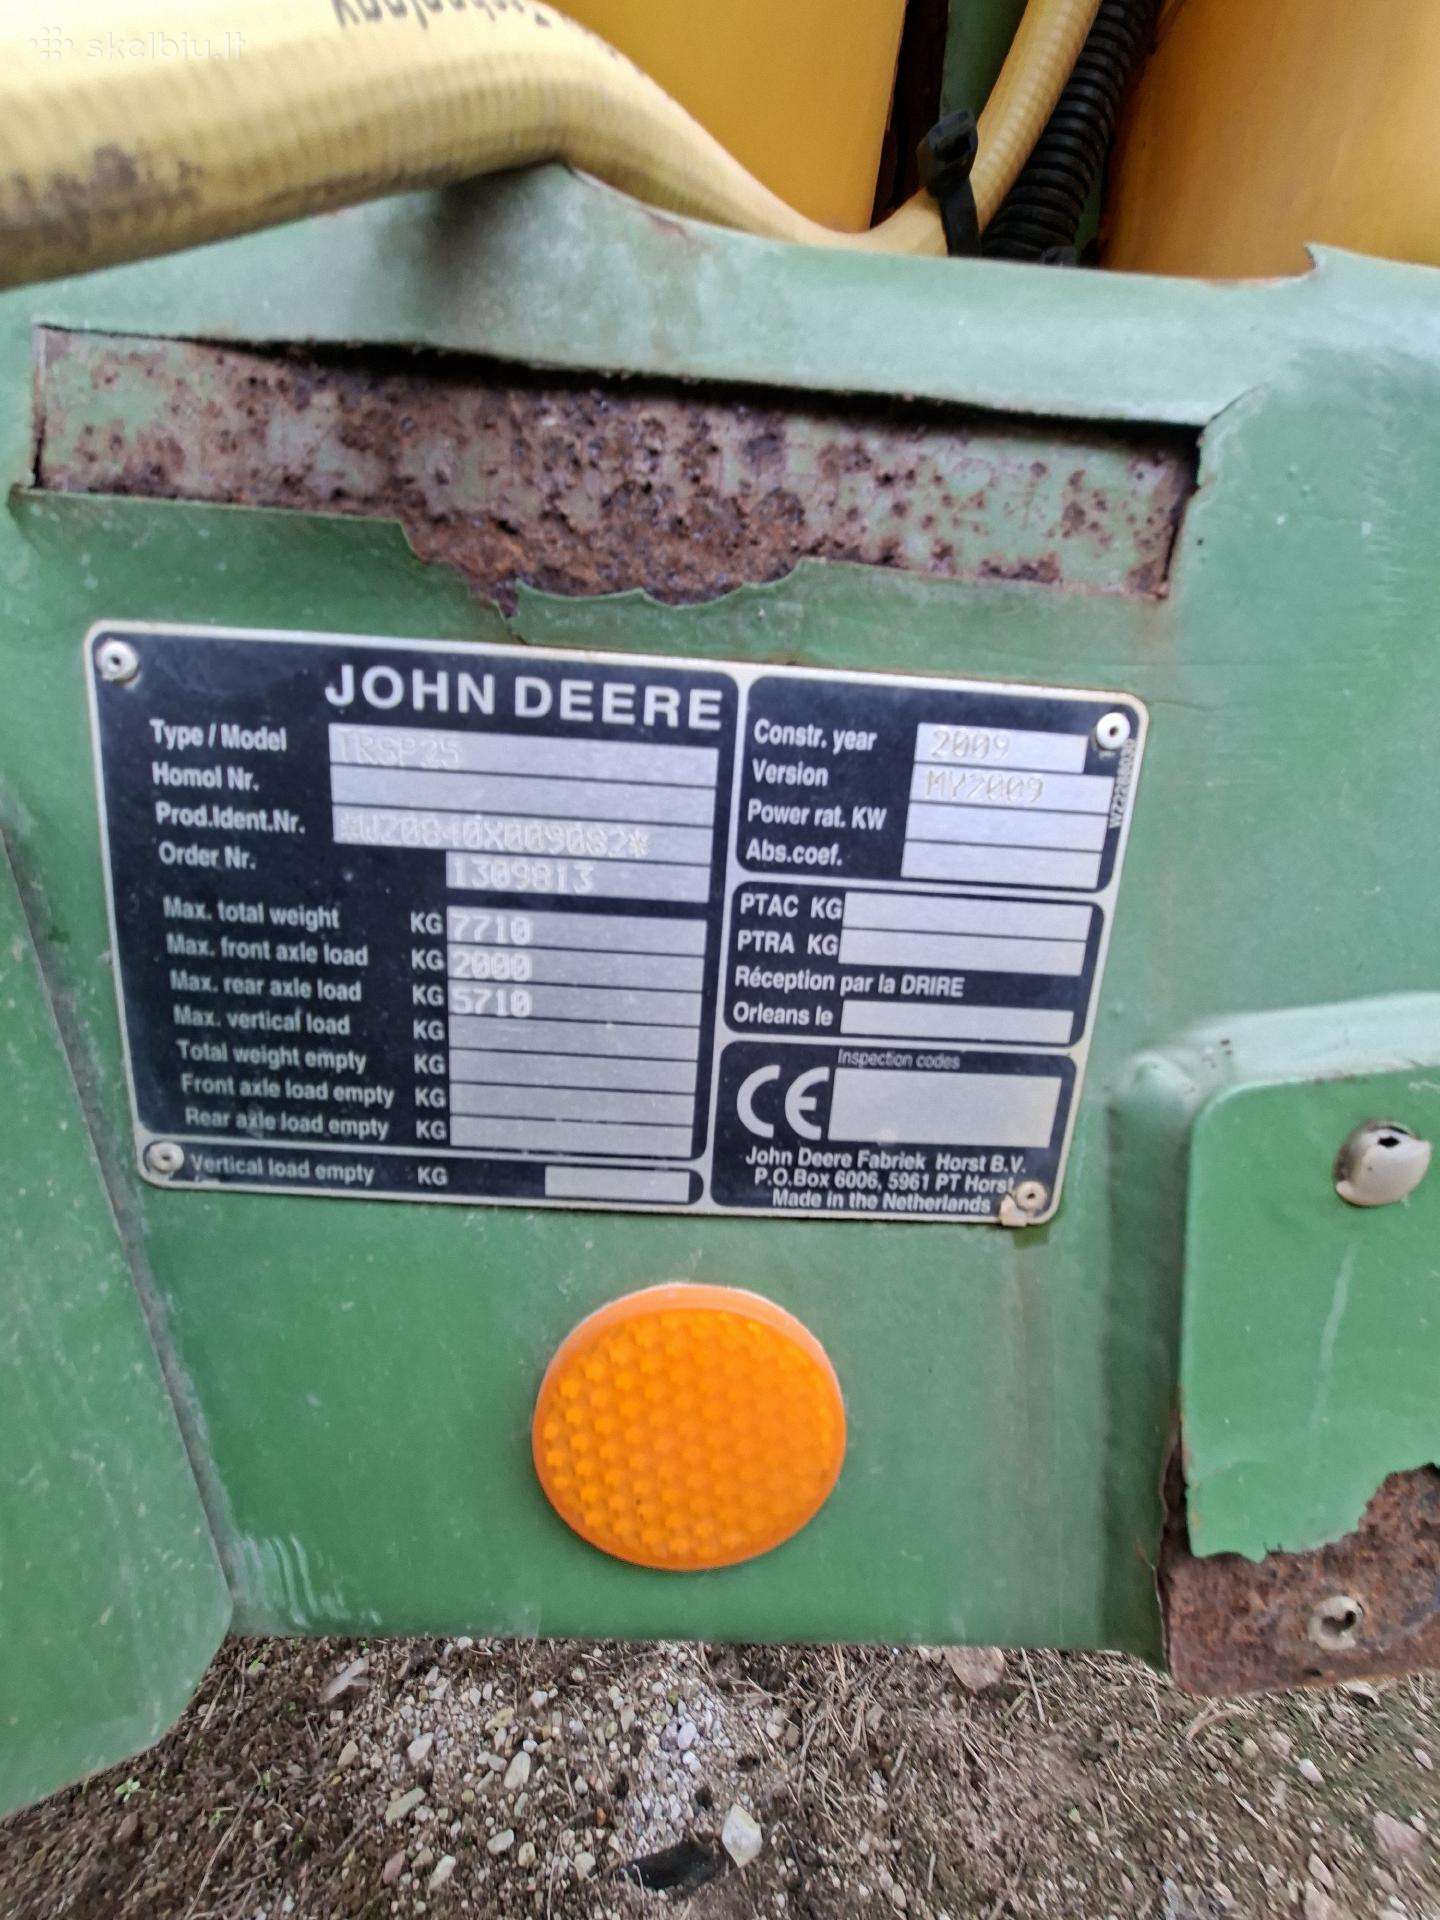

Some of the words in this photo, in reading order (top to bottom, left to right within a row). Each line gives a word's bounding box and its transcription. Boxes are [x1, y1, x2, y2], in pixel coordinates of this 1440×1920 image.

[325, 664, 496, 715] JOHN
[514, 676, 723, 730] DEERE
[149, 718, 204, 751] Type
[220, 724, 287, 752] Model
[753, 718, 828, 749] Constr.
[832, 730, 878, 754] year
[931, 728, 1010, 761] 2009
[152, 761, 222, 788] Homol
[228, 766, 259, 792] Nr.
[752, 759, 828, 787] Version
[747, 799, 810, 827] Power
[814, 806, 847, 828] rat.
[851, 807, 888, 830] KW
[158, 841, 220, 868] Order
[225, 845, 256, 870] Nr.
[746, 838, 842, 866] Abs.coef.
[162, 896, 212, 920] Max.
[217, 900, 264, 924] total
[269, 904, 340, 933] weight
[410, 911, 444, 935] KG
[740, 892, 799, 918] PTAC
[810, 896, 843, 921] KG
[451, 912, 533, 945] 7710
[737, 930, 795, 954] PTRA
[807, 933, 839, 956] KG
[166, 932, 215, 957] Max.
[220, 936, 270, 960] front
[275, 941, 318, 964] axle
[323, 943, 369, 967] load
[411, 949, 444, 971] KG
[451, 951, 533, 981] 2000
[170, 969, 218, 993] Max.
[223, 977, 264, 996] rear
[269, 977, 312, 999] axle
[317, 979, 362, 1002] load
[412, 985, 444, 1006] KG
[735, 965, 835, 994] Réception
[840, 976, 874, 996] par
[878, 973, 896, 994] la
[901, 974, 965, 998] DRIRE
[451, 988, 533, 1017] 5710
[733, 1001, 810, 1026] Orleans
[815, 1005, 833, 1026] le
[173, 1004, 221, 1027] Max.
[226, 1008, 301, 1033] vertical
[306, 1013, 350, 1036] load
[413, 1020, 446, 1041] KG
[176, 1039, 228, 1062] Total
[233, 1044, 299, 1071] weight
[305, 1051, 367, 1074] empty
[413, 1054, 446, 1075] KG
[838, 1049, 913, 1069] Inspection
[916, 1052, 961, 1070] codes
[181, 1073, 235, 1096] Front
[239, 1076, 281, 1099] axle
[285, 1079, 328, 1100] load
[333, 1086, 395, 1109] empty
[414, 1088, 446, 1108] KG
[185, 1106, 230, 1128] Rear
[236, 1109, 277, 1131] axle
[281, 1112, 324, 1133] load
[328, 1119, 390, 1142] empty
[416, 1120, 447, 1141] KG
[190, 1154, 263, 1177] Vertical
[268, 1158, 310, 1180] load
[315, 1165, 375, 1188] empty
[417, 1166, 448, 1187] KG
[745, 1146, 793, 1167] John
[797, 1147, 852, 1168] Deere
[857, 1150, 925, 1171] Fabriek
[935, 1152, 986, 1172] Horst
[990, 1155, 1026, 1174] B.V.
[834, 1171, 882, 1191] 6006,
[887, 1172, 929, 1190] 5961
[935, 1174, 961, 1191] PT
[964, 1176, 1014, 1194] Horst
[772, 1188, 822, 1208] Made
[827, 1191, 844, 1209] in
[848, 1191, 878, 1210] the
[883, 1192, 991, 1213] Netherlands
